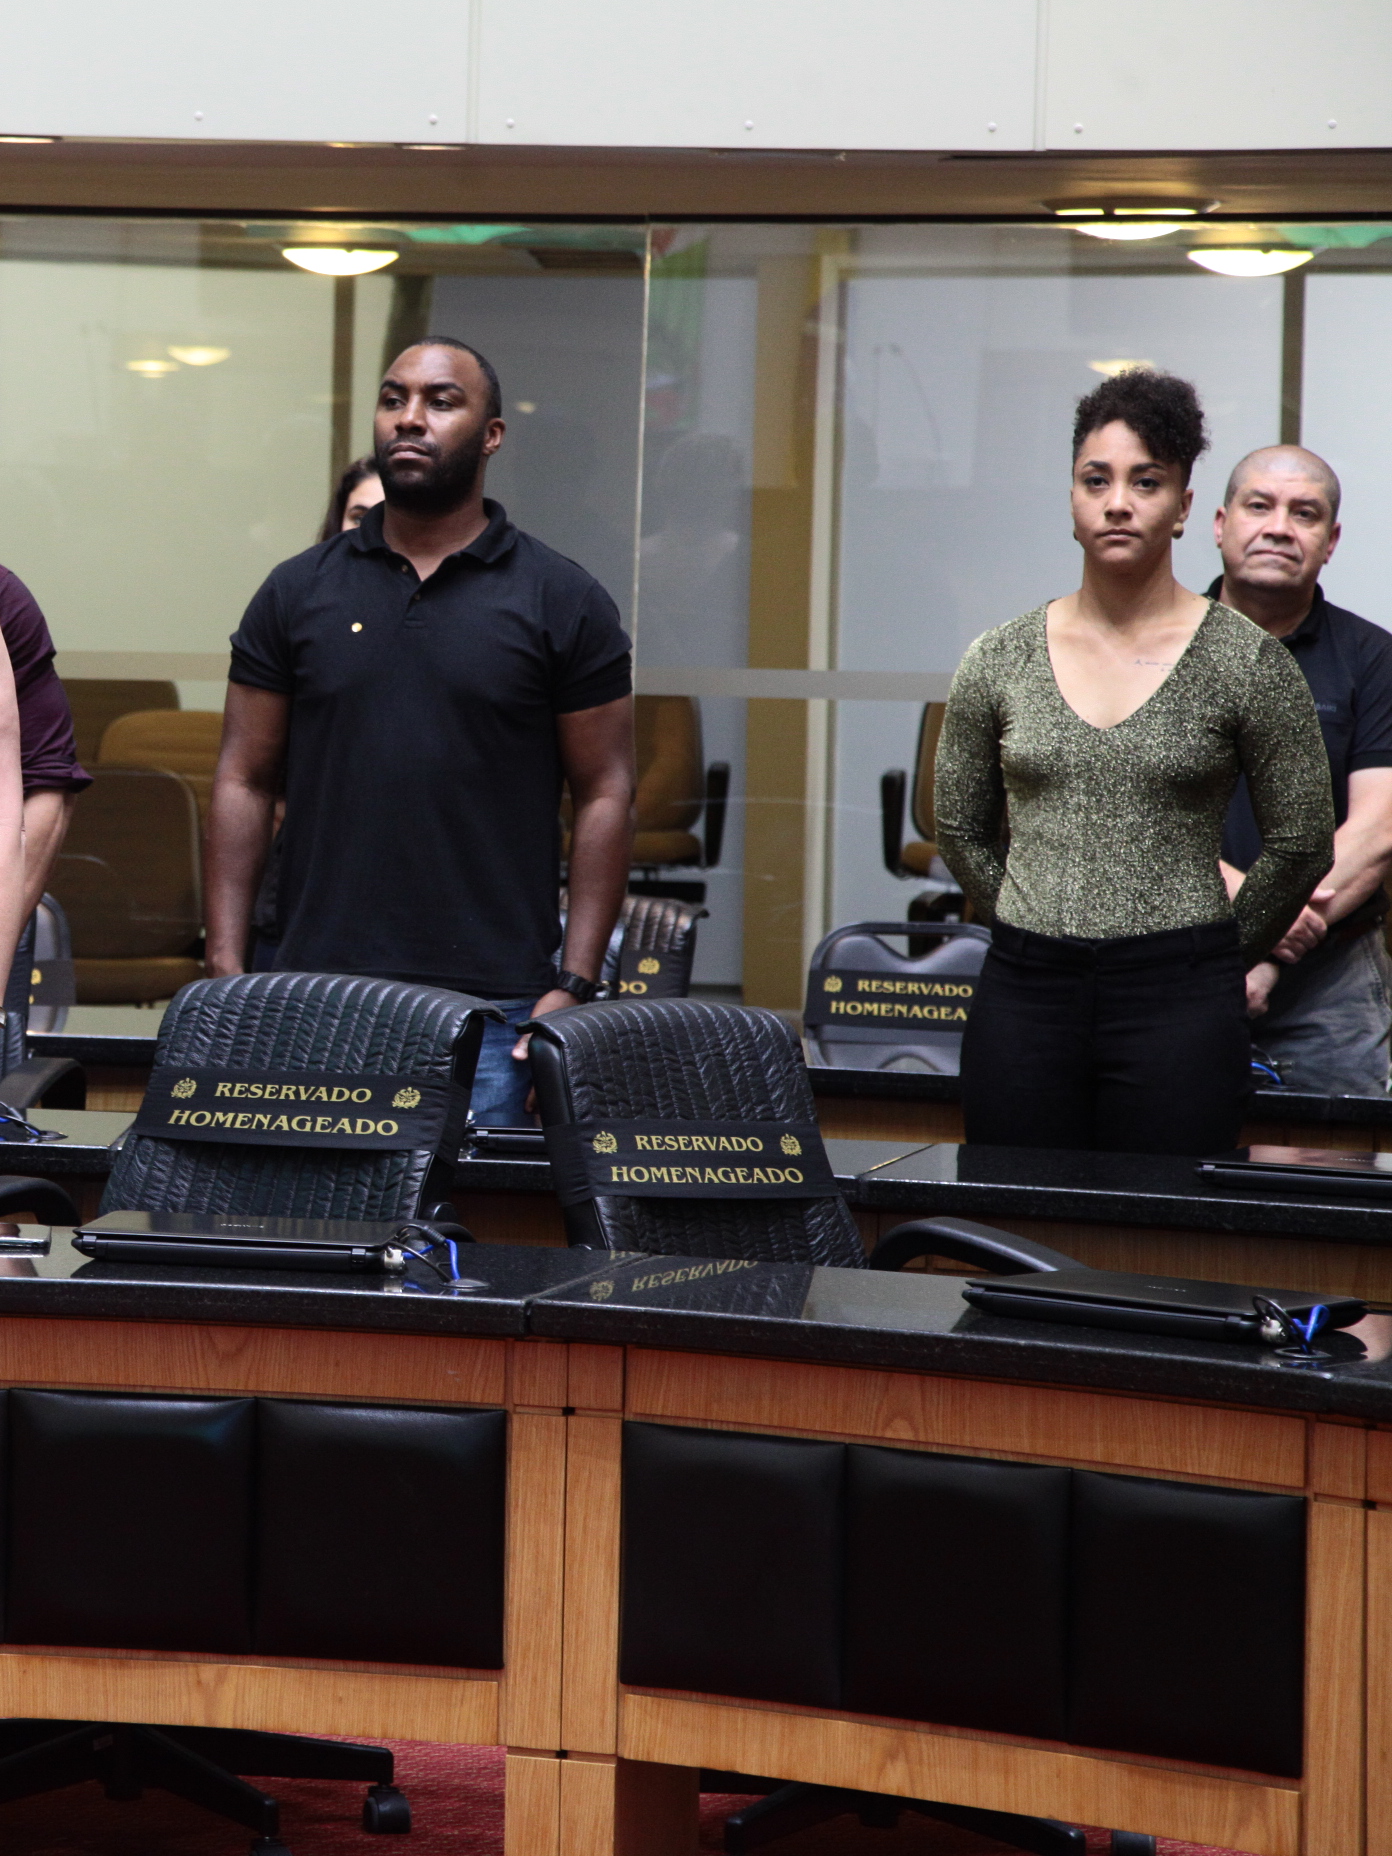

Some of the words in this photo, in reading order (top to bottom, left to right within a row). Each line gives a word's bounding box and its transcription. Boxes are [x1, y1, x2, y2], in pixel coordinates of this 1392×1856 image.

[857, 978, 974, 998] RESERVADO
[829, 1000, 968, 1022] HOMENAGEA
[214, 1082, 372, 1103] RESERVADO
[167, 1109, 399, 1136] HOMENAGEADO
[634, 1135, 764, 1152] RESERVADO
[610, 1166, 804, 1184] HOMENAGEADO
